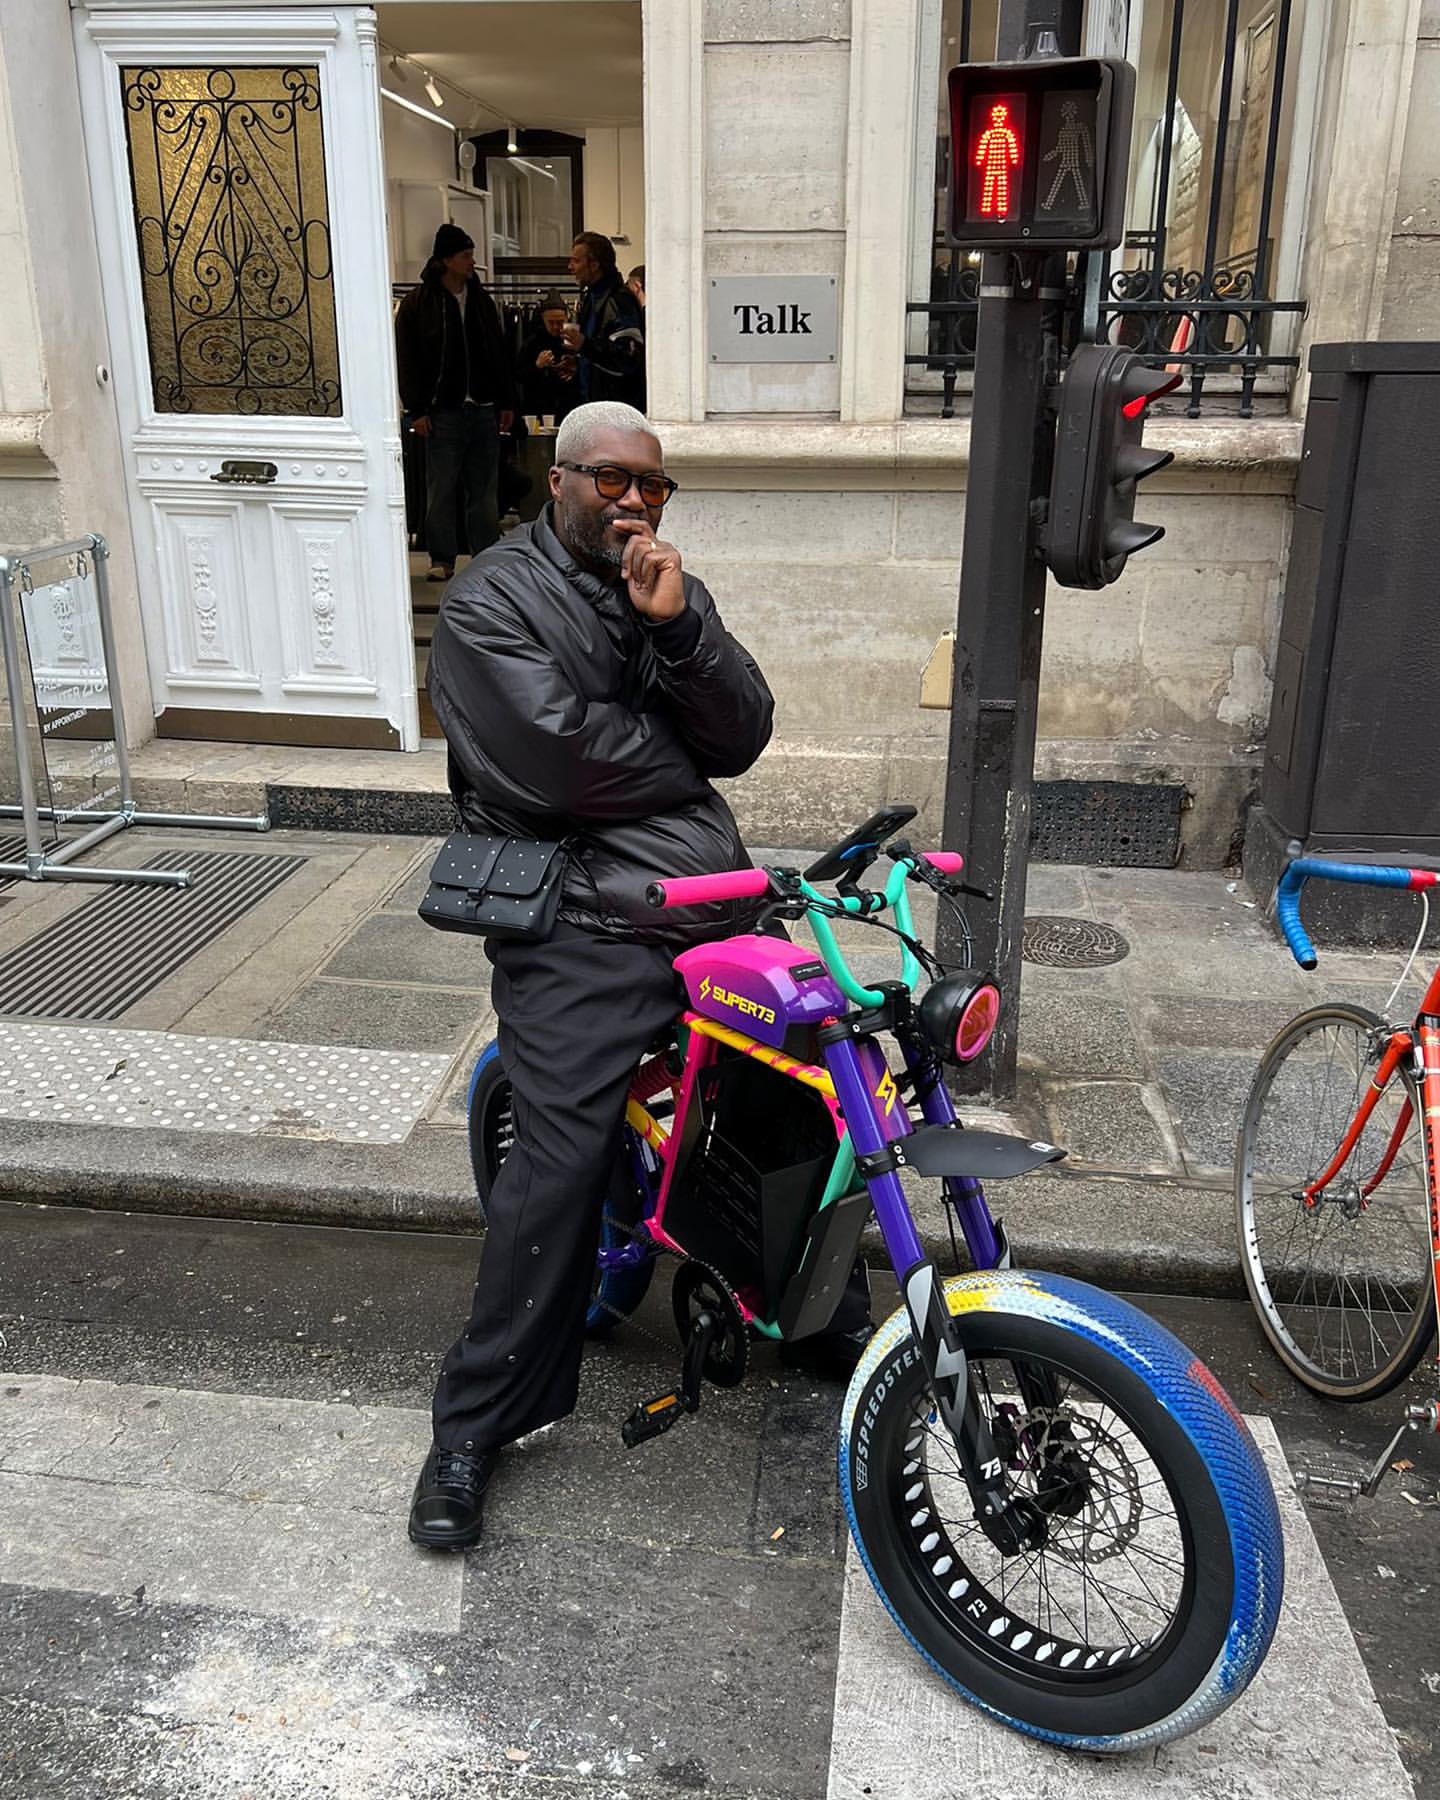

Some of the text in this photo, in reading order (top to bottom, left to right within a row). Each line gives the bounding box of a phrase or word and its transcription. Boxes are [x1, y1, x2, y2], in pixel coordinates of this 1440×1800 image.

[733, 304, 812, 335] Talk
[712, 984, 776, 1024] SUPER73
[980, 1456, 1002, 1480] 73
[967, 1598, 988, 1618] 73
